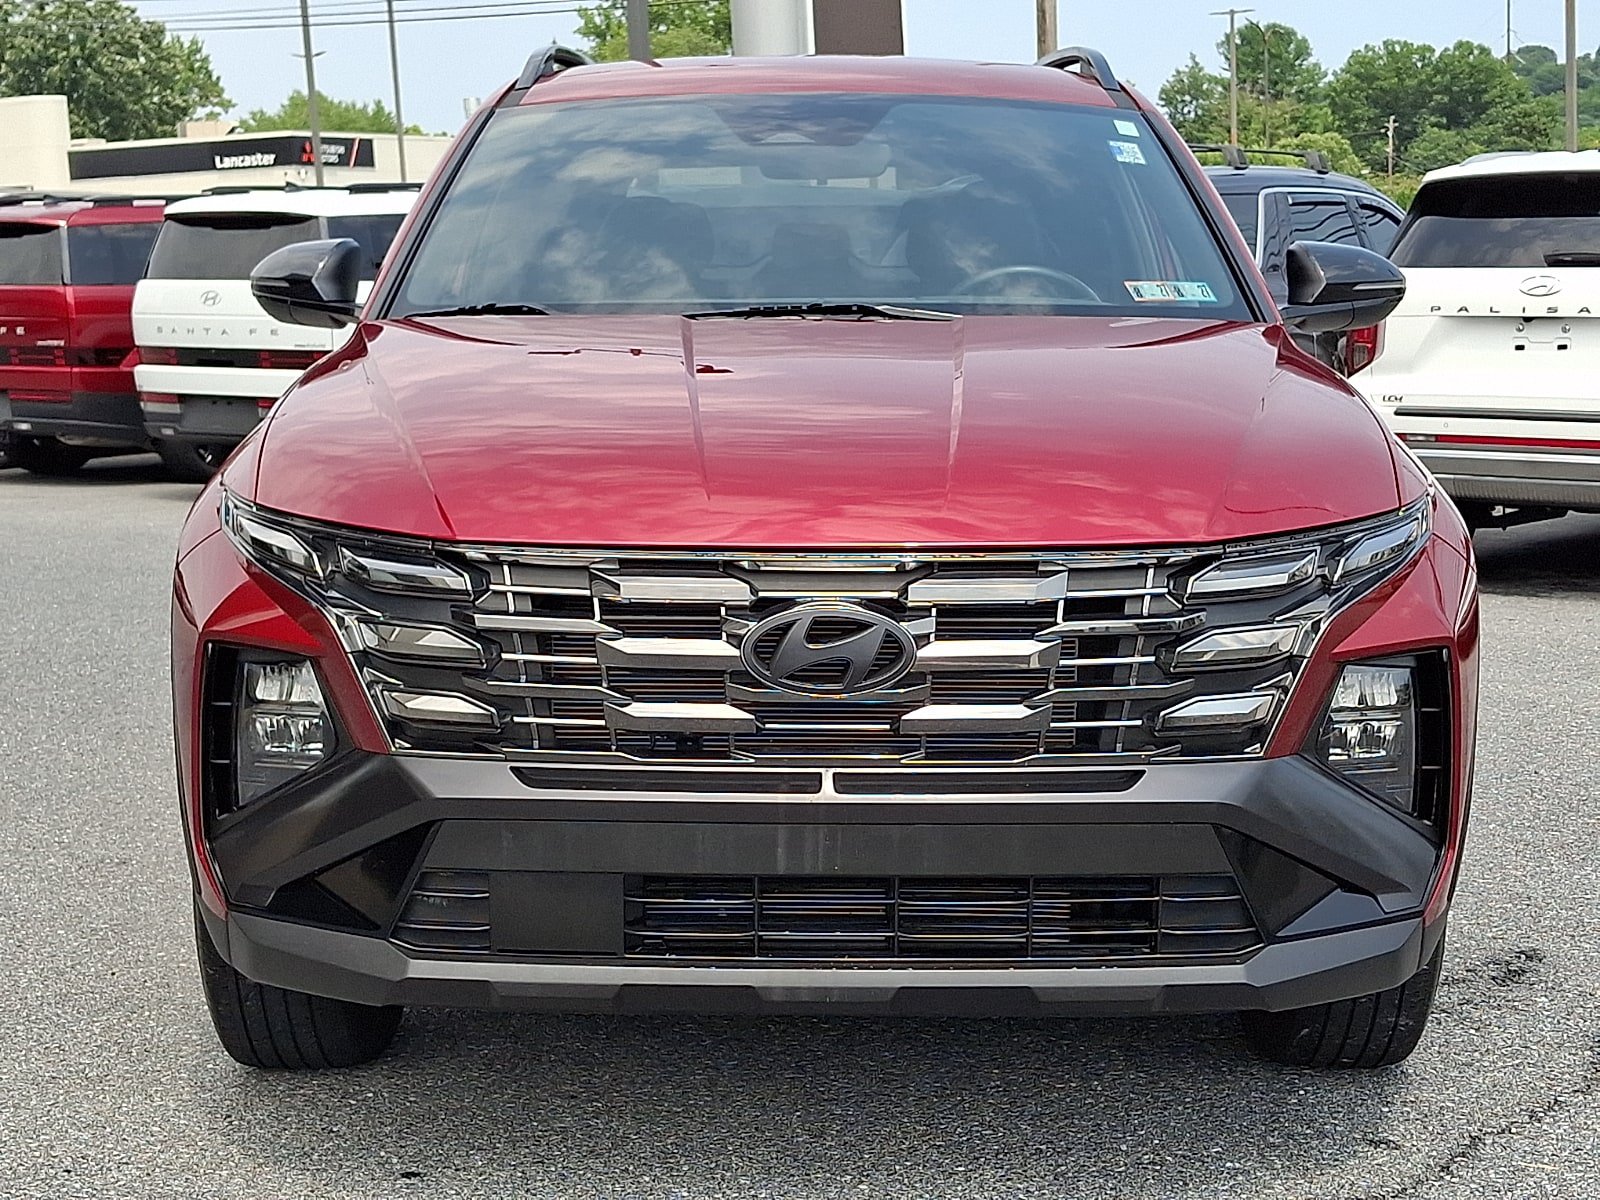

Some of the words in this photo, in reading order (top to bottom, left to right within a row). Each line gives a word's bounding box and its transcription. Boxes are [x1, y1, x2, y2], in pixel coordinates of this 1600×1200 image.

[214, 152, 277, 169] Lancaster
[1430, 305, 1592, 314] PALISA
[157, 326, 230, 336] SANTA
[250, 327, 279, 336] FE
